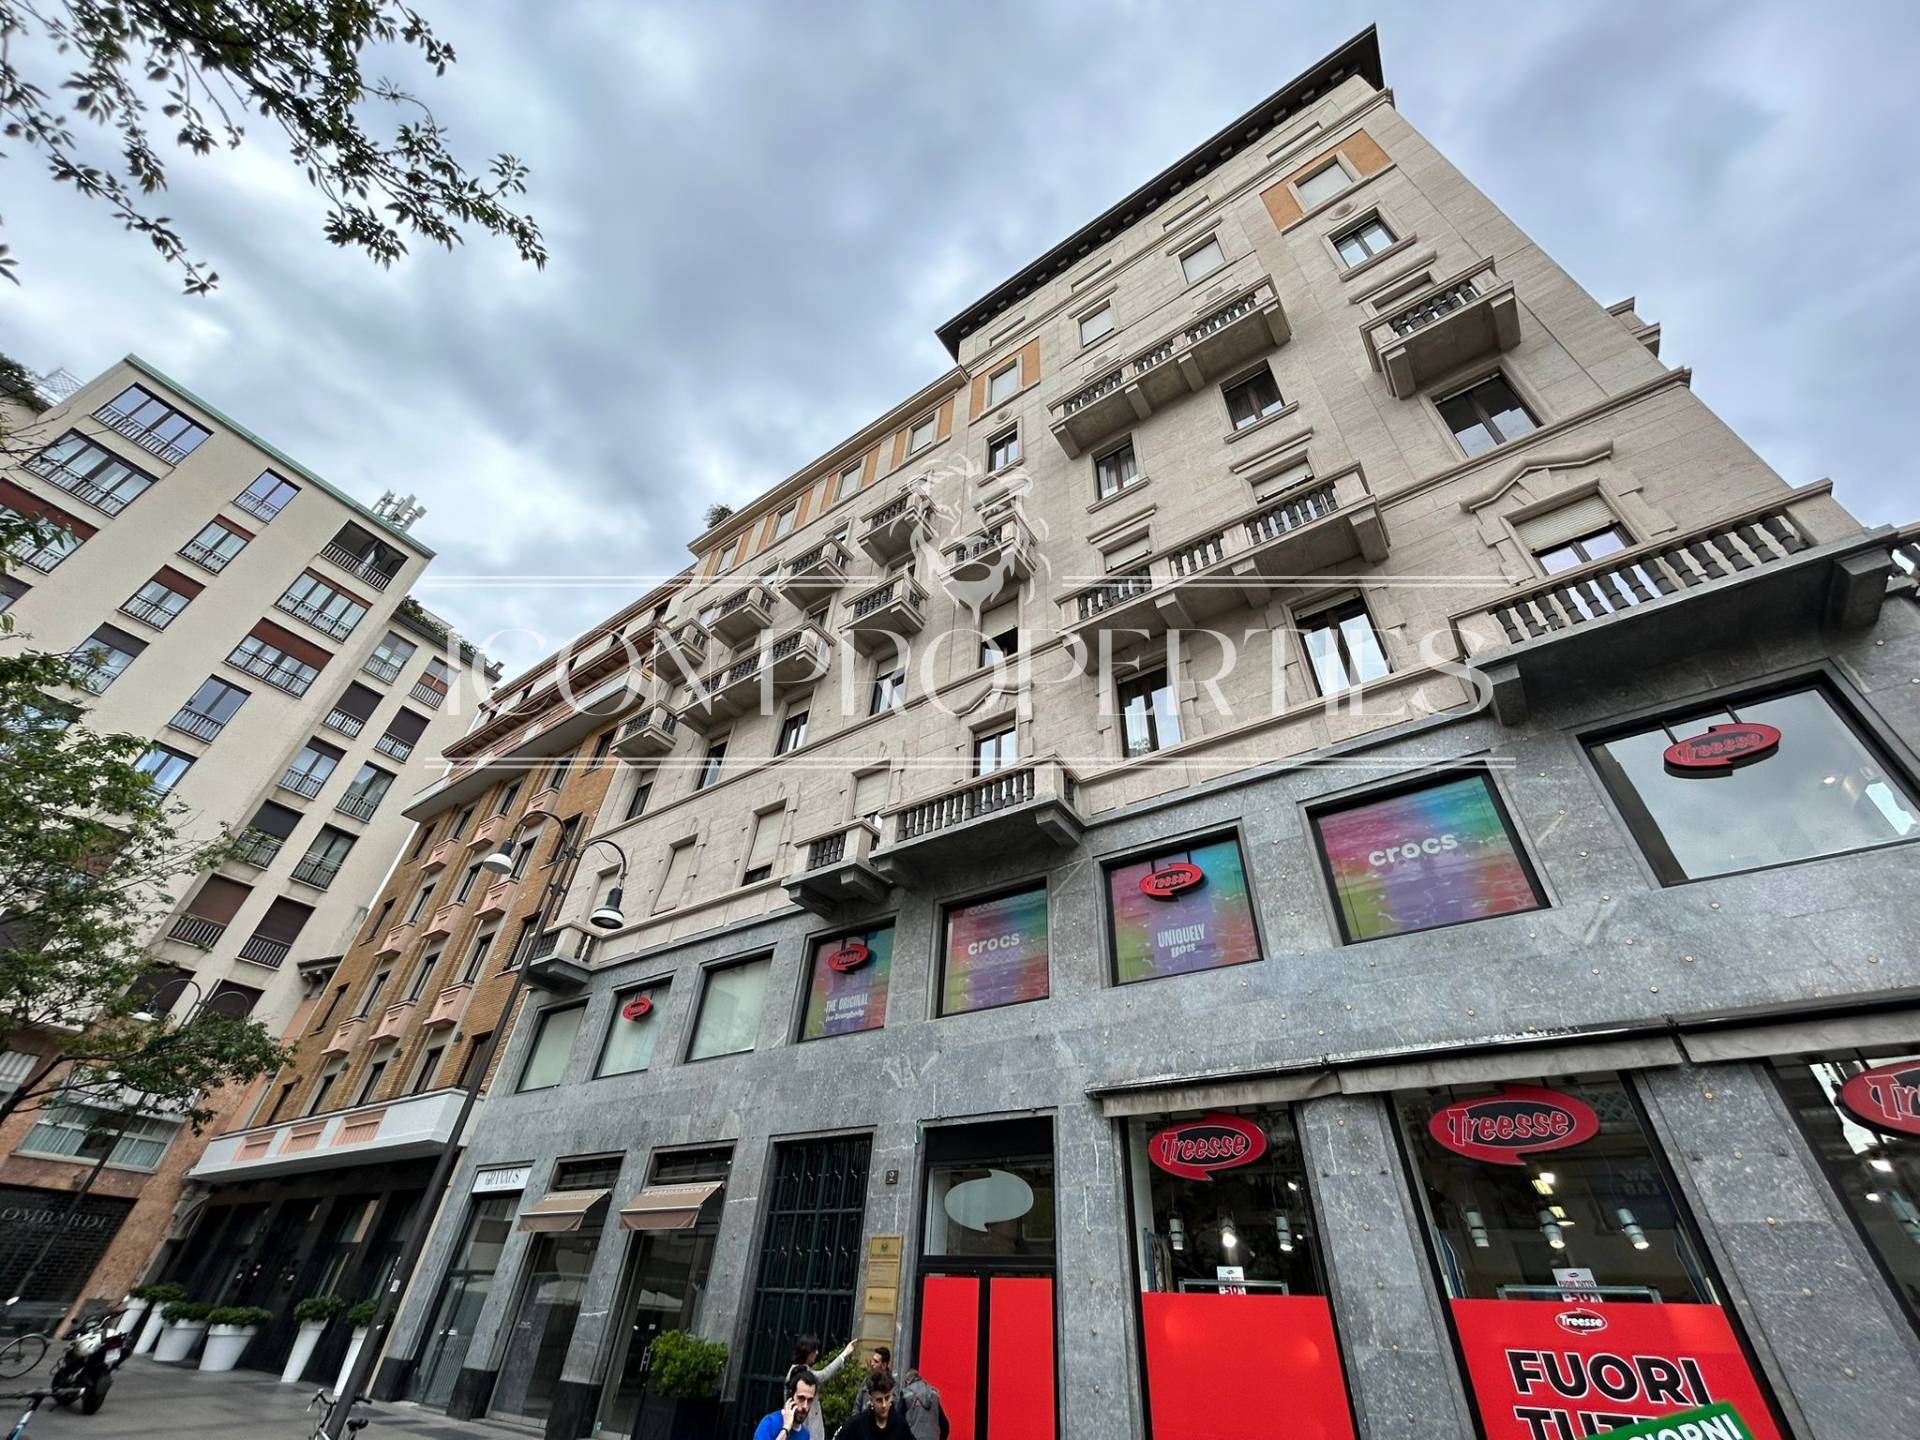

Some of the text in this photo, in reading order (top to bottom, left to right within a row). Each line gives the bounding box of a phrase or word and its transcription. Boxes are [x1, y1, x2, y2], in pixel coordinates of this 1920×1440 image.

[1676, 733, 1759, 762] Treesse
[1368, 833, 1458, 866] crocs
[967, 932, 1020, 955] crocs
[1158, 923, 1204, 948] UNIQUELY
[1863, 1073, 1920, 1121] Tr
[1446, 1108, 1569, 1146] Treesse
[1162, 1131, 1246, 1166] Treesse
[1560, 1314, 1603, 1327] Treesse
[1505, 1349, 1714, 1407] FUORI
